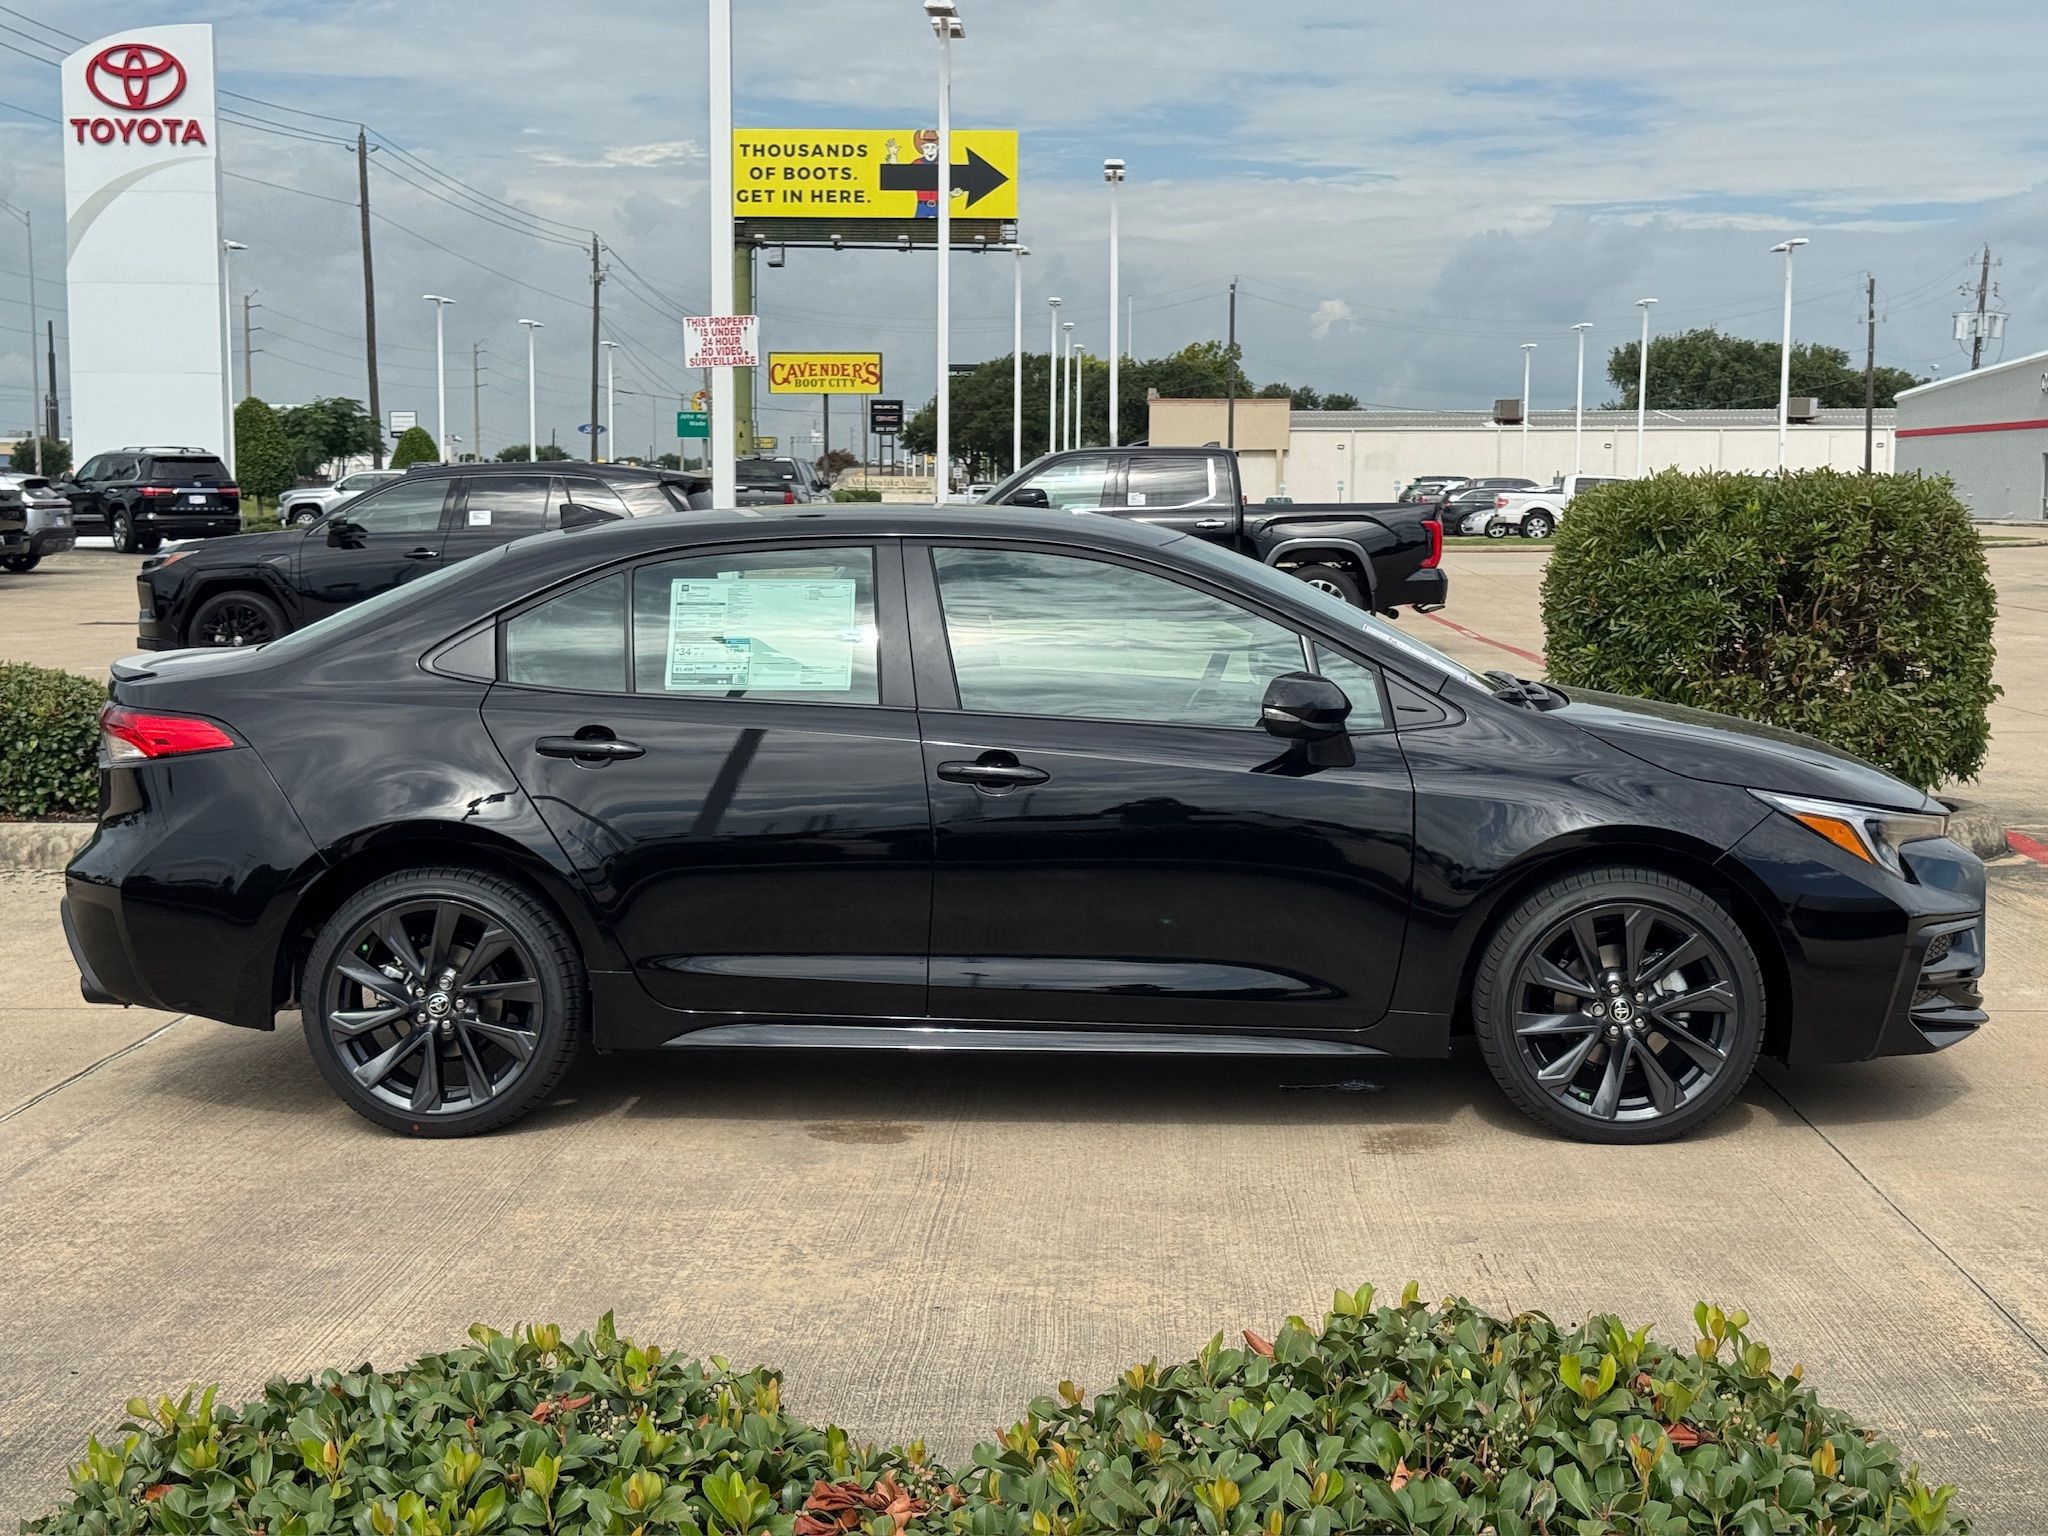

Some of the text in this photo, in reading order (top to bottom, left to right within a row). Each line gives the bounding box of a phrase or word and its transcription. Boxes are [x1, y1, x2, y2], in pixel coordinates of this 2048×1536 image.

[70, 118, 206, 145] TOYOTA
[739, 144, 868, 158] THOUSANDS
[749, 167, 858, 180] OF BOOTS.
[736, 189, 871, 203] GET IN HERE.
[686, 317, 755, 327] THIS PROPERTY
[701, 327, 741, 337] IS UNDER
[702, 337, 740, 346] 24 HOUR
[701, 347, 742, 356] HD VIDEO
[689, 356, 756, 366] SURVEILLANCE
[771, 362, 880, 386] CAVENDER'S
[795, 378, 856, 387] BOOT CITY
[851, 478, 899, 487] Medowlake
